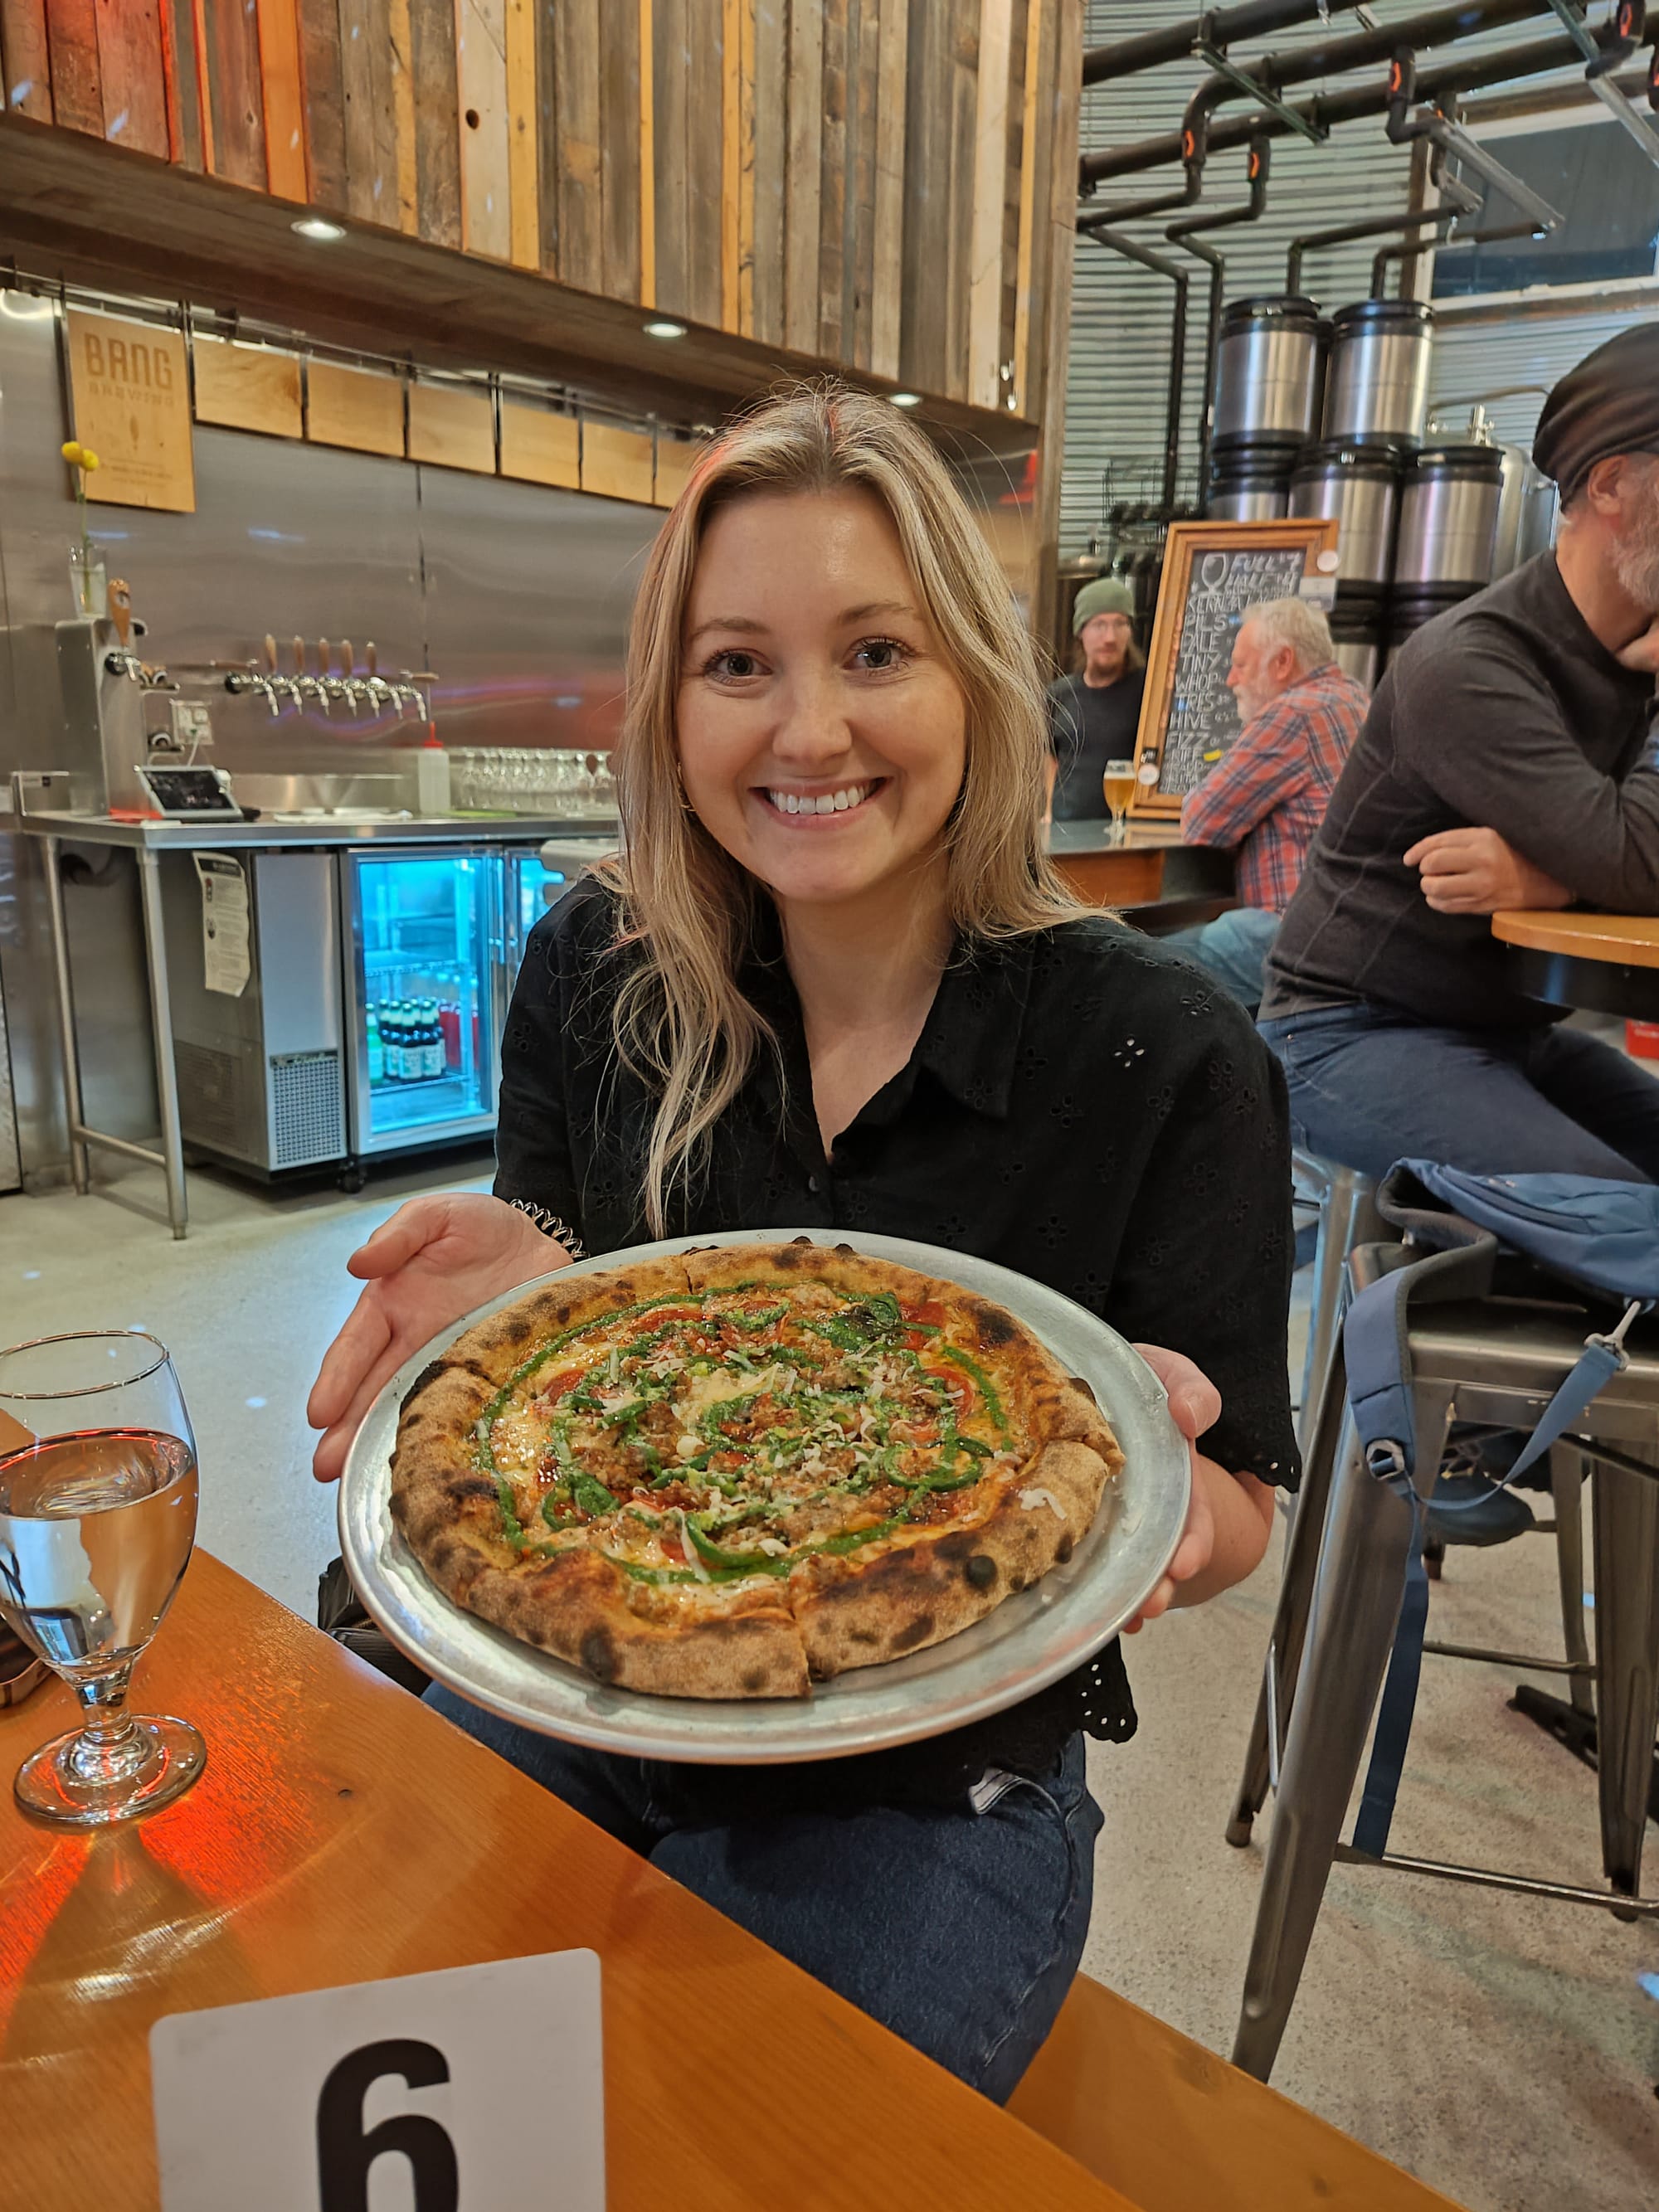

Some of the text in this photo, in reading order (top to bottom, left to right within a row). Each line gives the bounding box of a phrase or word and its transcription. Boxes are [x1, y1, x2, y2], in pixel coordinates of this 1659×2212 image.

[84, 333, 173, 391] BANG
[1180, 632, 1221, 654] PALE
[1180, 651, 1221, 673] TINY
[1169, 712, 1210, 730] HIVE
[1165, 732, 1209, 749] FIZZ
[316, 2038, 460, 2212] 6
